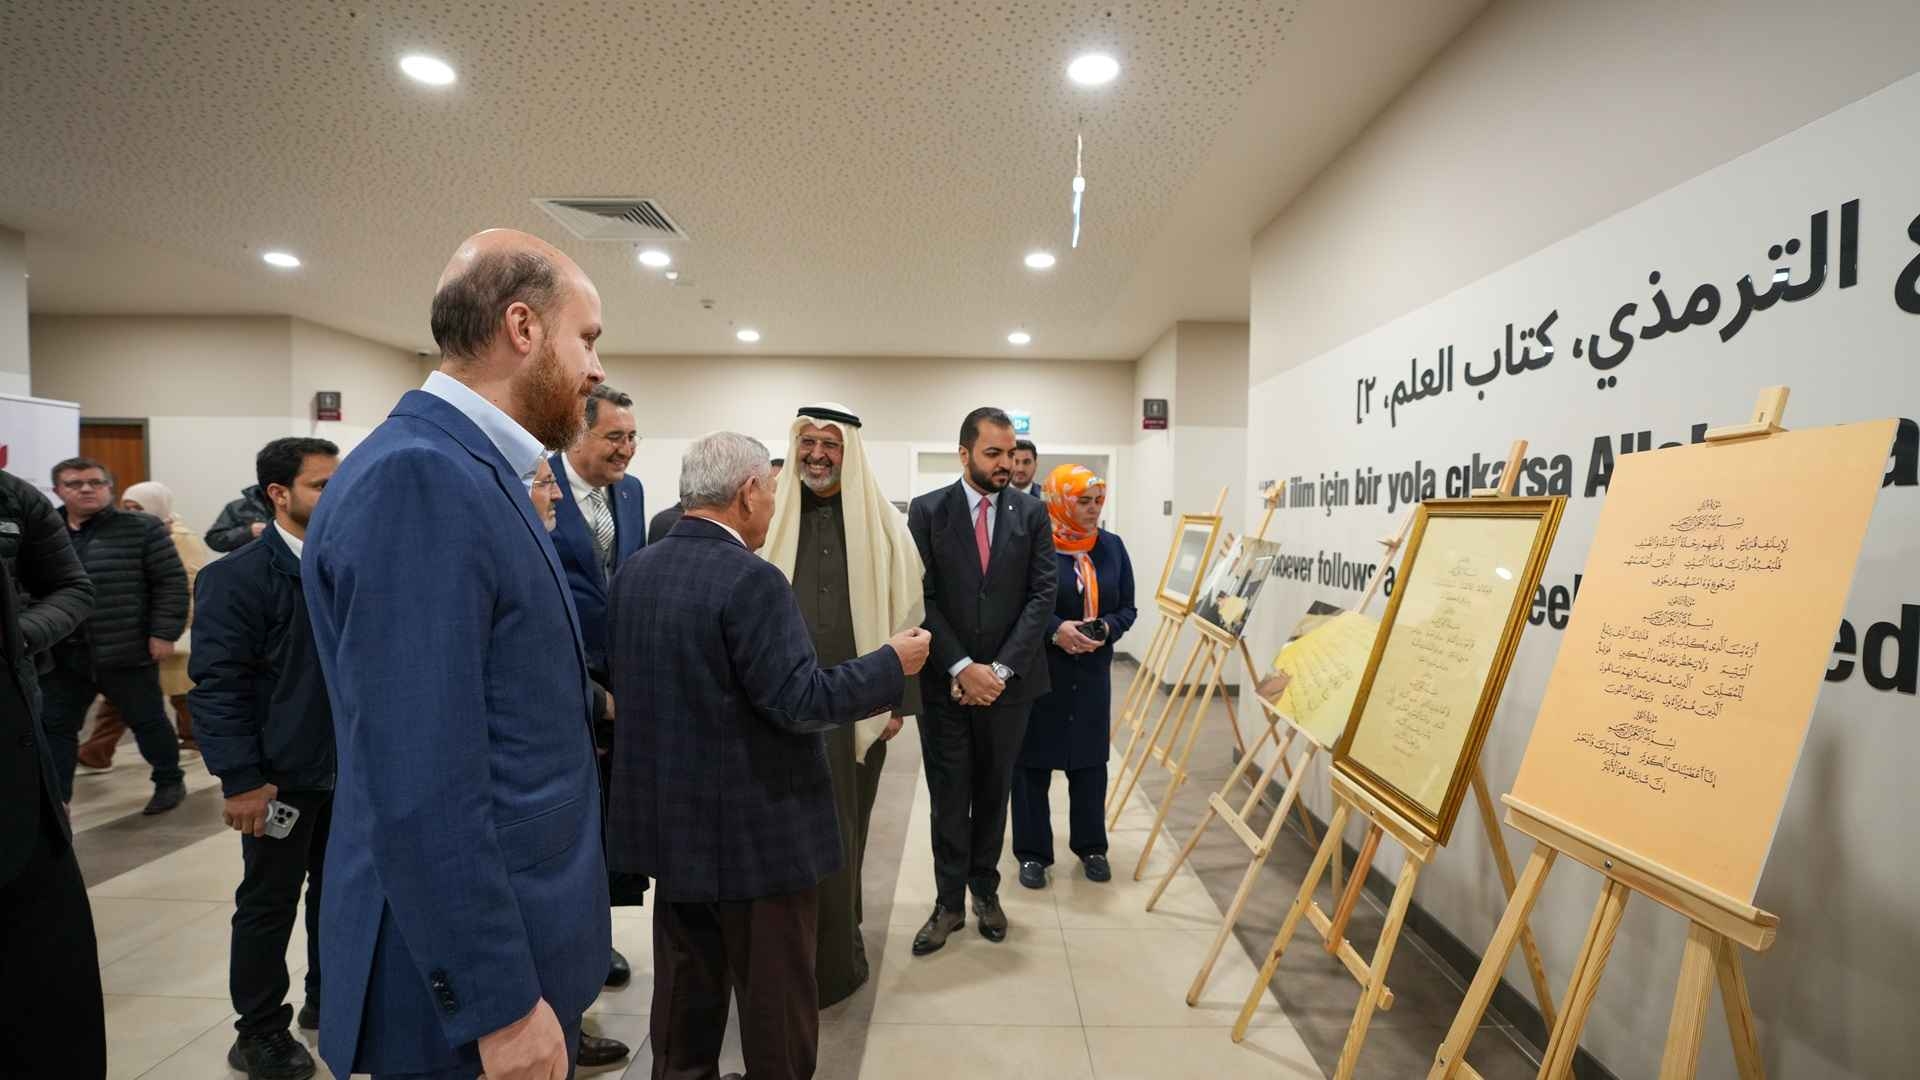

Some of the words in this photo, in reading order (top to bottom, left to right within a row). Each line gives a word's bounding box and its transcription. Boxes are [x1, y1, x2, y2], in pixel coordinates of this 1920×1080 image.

[1573, 199, 1859, 390] الترمذي،
[1384, 345, 1453, 428] العلم،
[1464, 309, 1558, 401] كتاب
[1290, 476, 1315, 508] ilim
[1320, 473, 1349, 516] için
[1355, 467, 1382, 505] bir
[1387, 460, 1436, 513] yola
